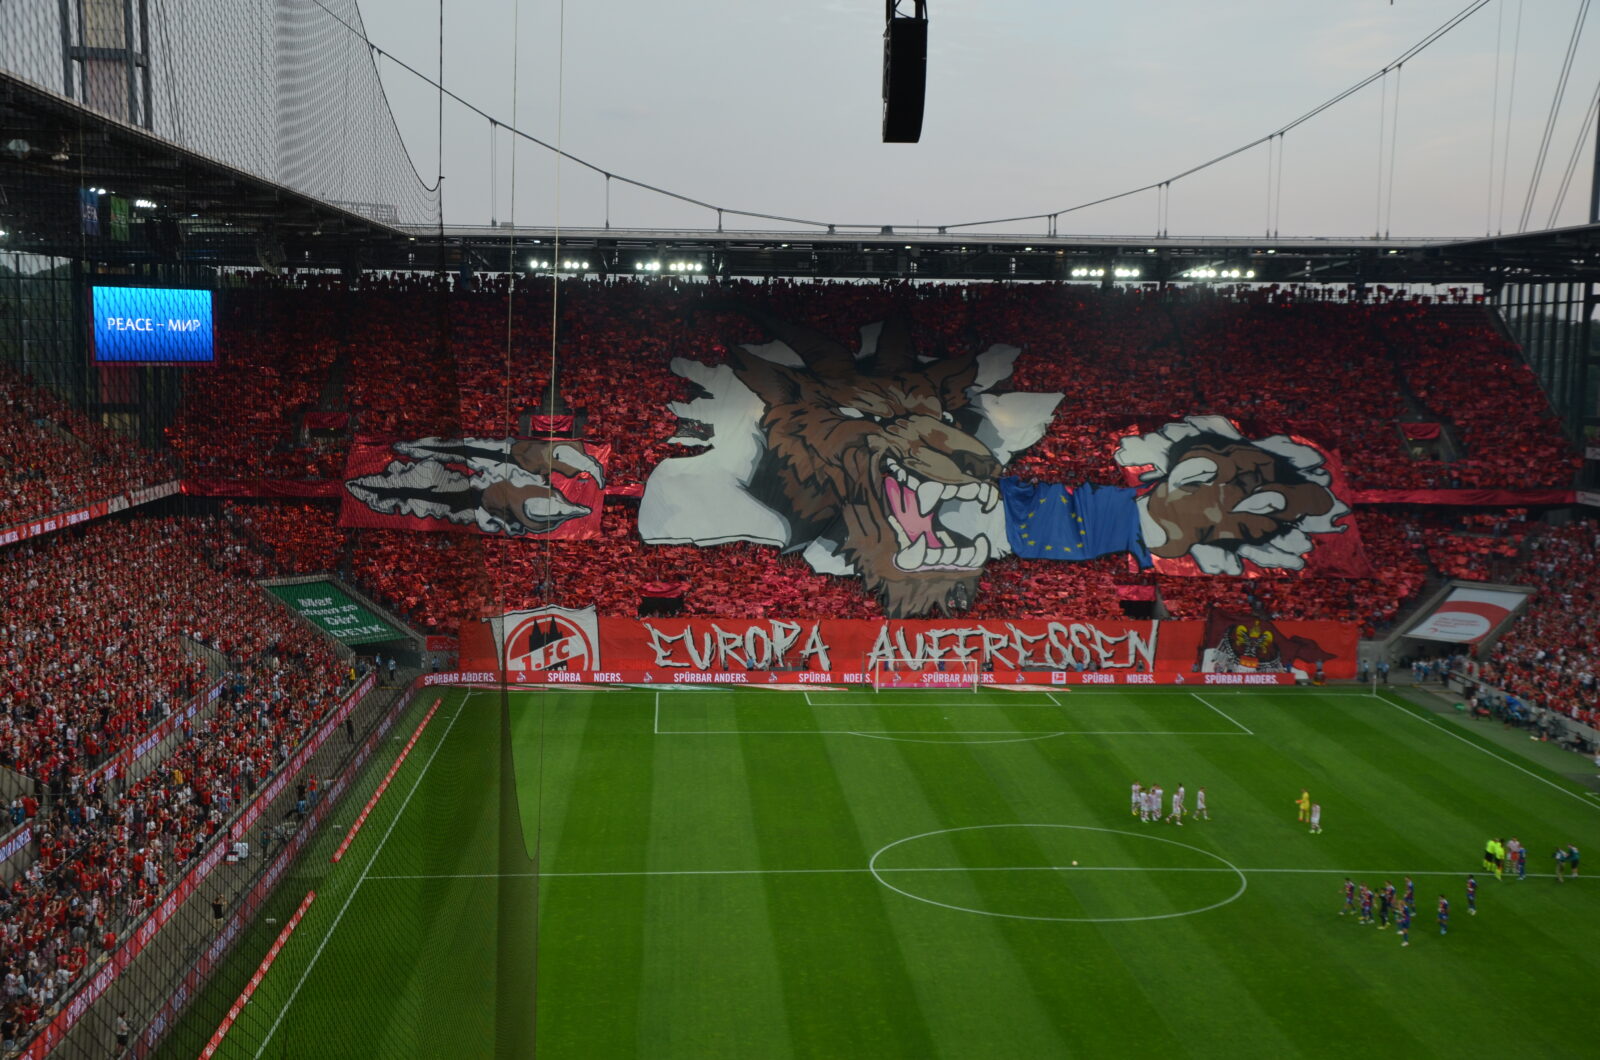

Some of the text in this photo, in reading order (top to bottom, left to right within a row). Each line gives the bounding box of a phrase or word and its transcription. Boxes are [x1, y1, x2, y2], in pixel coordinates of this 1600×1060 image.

[107, 317, 153, 331] PEACE
[168, 319, 201, 332] МИР
[330, 624, 387, 638] DEVK
[643, 619, 1159, 672] EUROPA AUFFRESSEN
[424, 672, 459, 686] SPÜRBAR
[673, 672, 749, 683] SPÜRBAR ANDERS.
[922, 671, 960, 683] SPÜRBAR
[1204, 673, 1279, 684] SPÜRBAR ANDERS.
